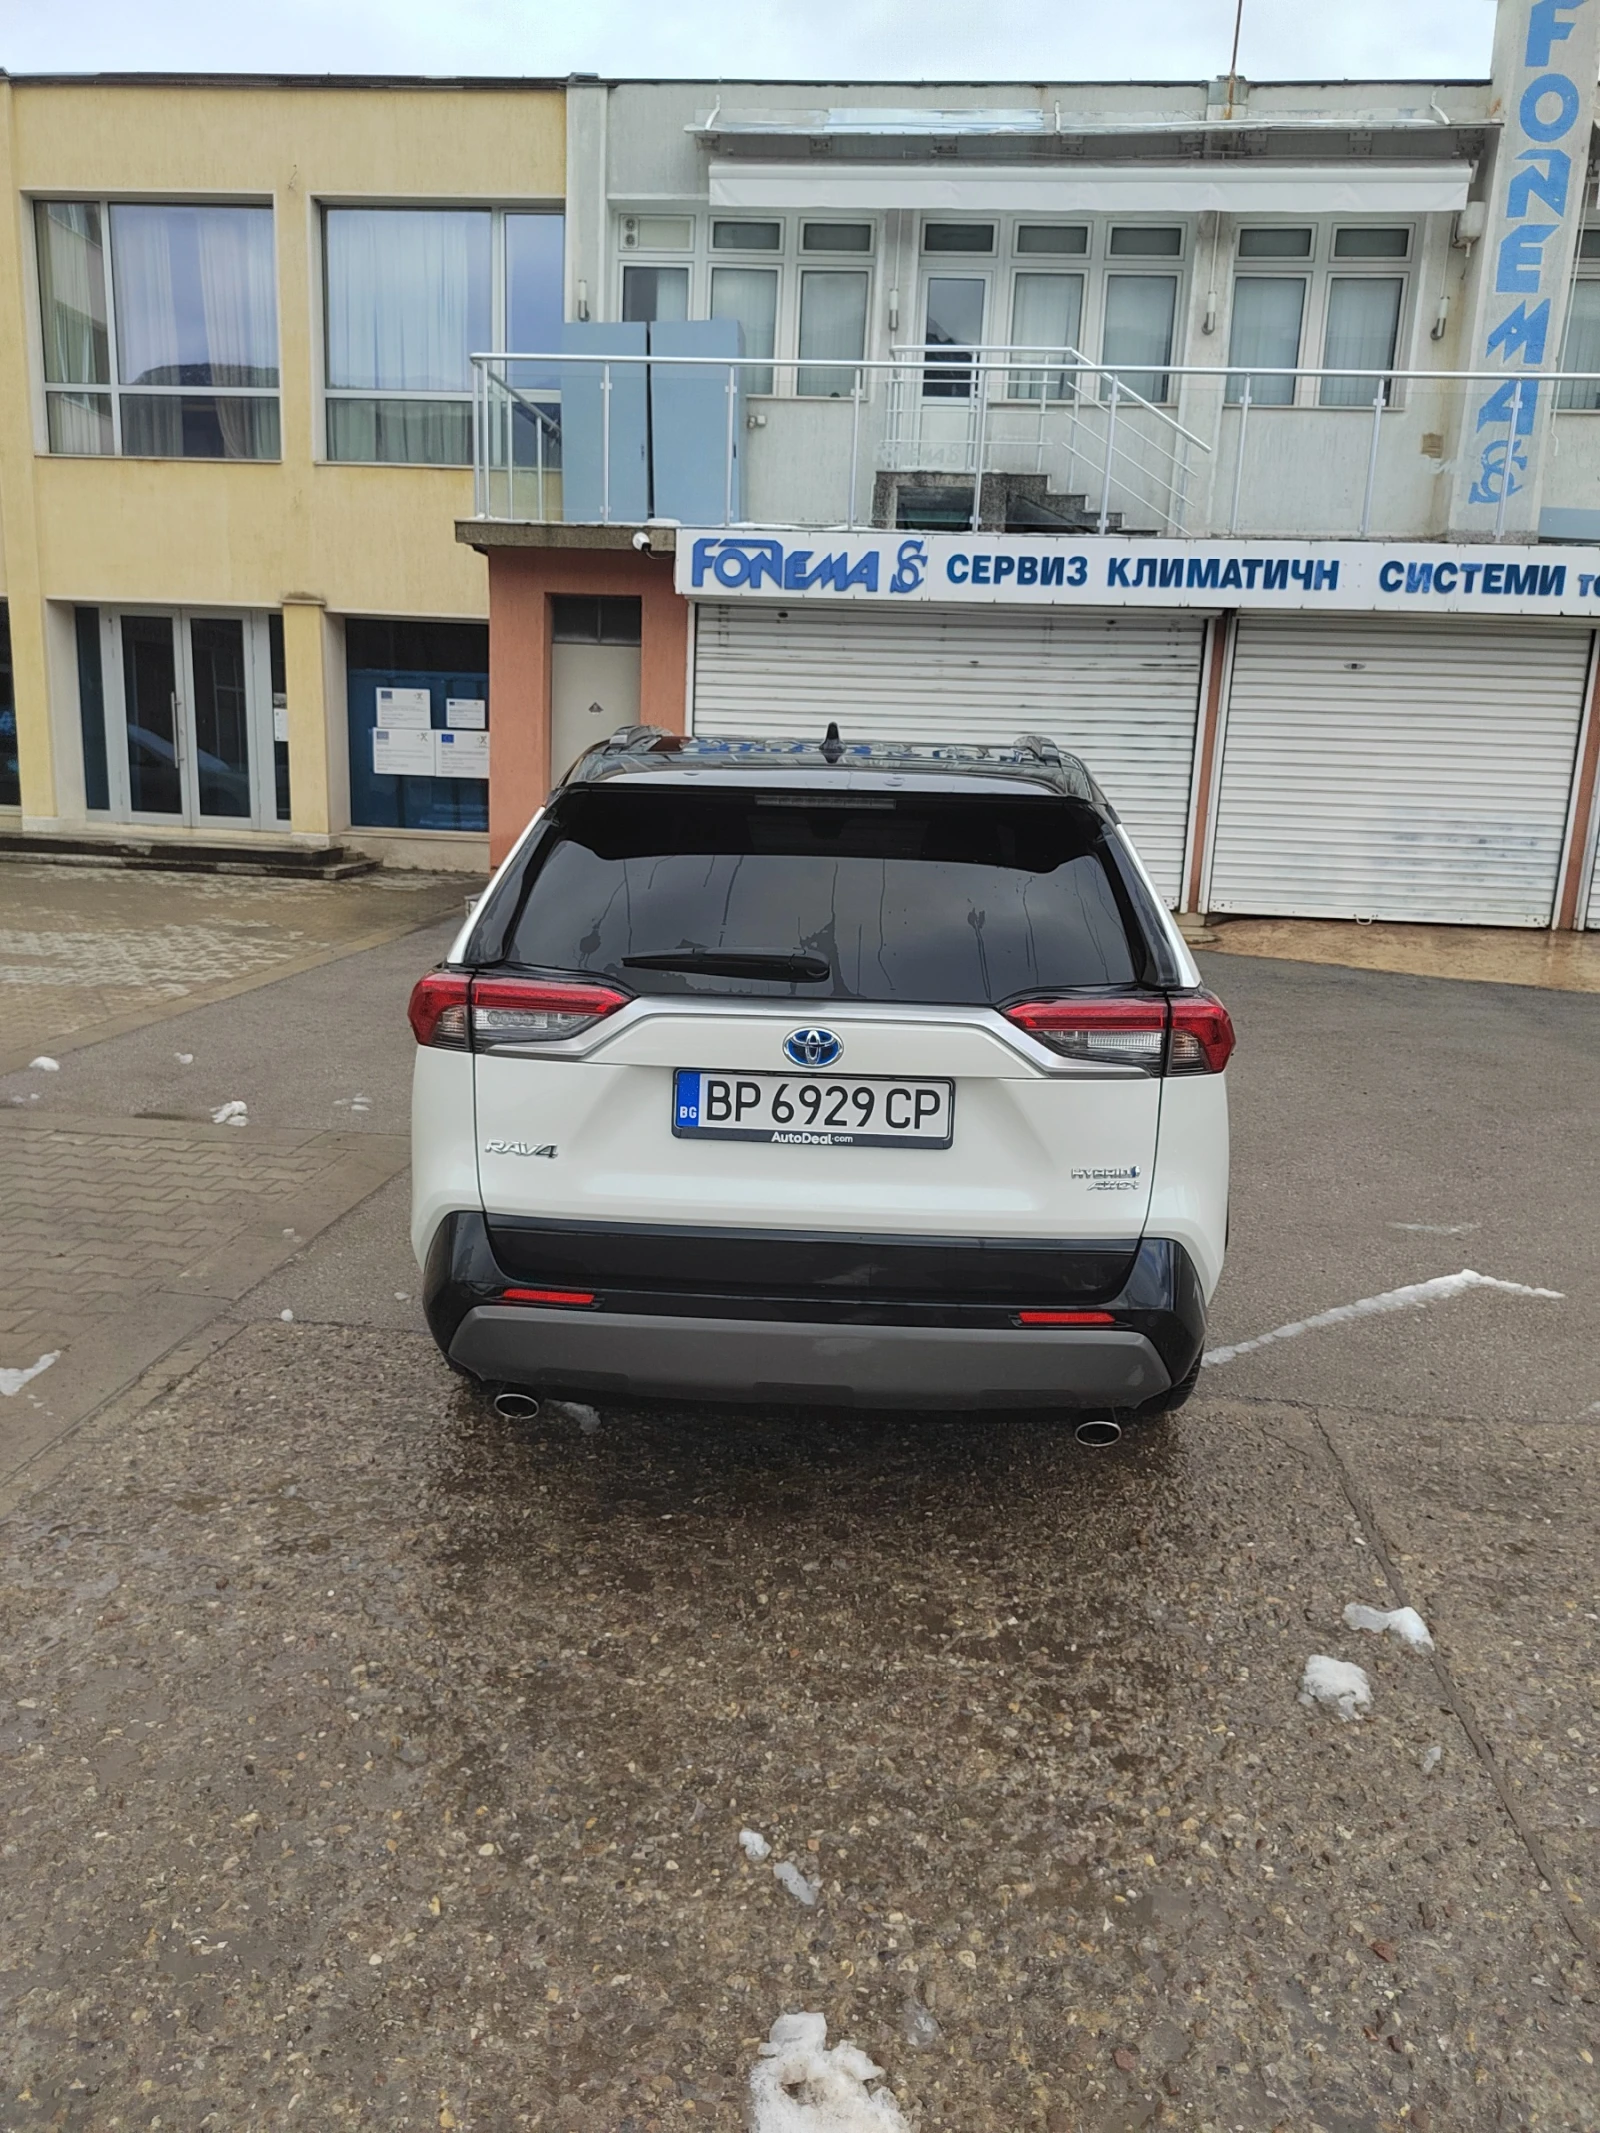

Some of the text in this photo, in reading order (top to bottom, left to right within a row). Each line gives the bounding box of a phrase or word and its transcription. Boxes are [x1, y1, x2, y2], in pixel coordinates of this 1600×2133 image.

[692, 538, 880, 592] FONEMA
[946, 553, 1088, 587] СЕРВИЗ
[1107, 557, 1340, 590] КЛИМАТИЧН
[1379, 560, 1567, 597] СИСТЕМИ
[679, 1106, 698, 1120] BG
[771, 1083, 875, 1128] 6929
[484, 1139, 559, 1159] RAV4
